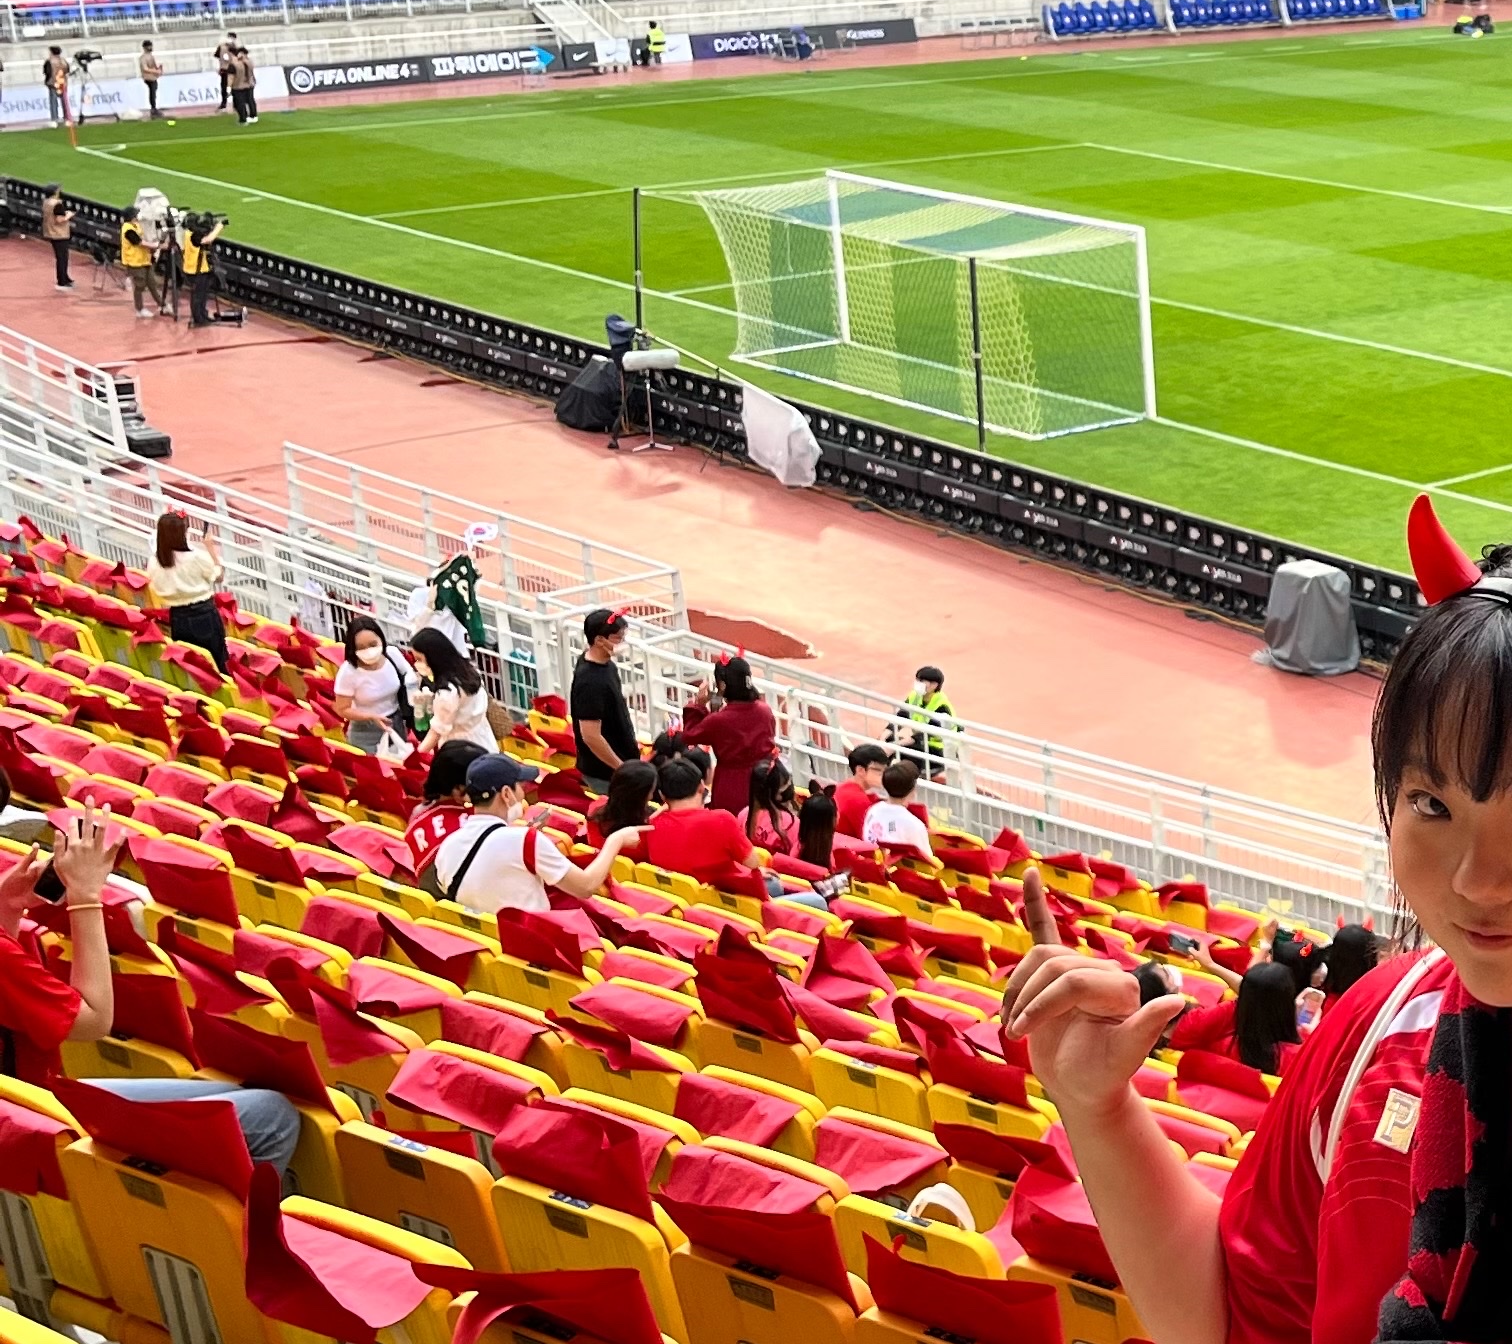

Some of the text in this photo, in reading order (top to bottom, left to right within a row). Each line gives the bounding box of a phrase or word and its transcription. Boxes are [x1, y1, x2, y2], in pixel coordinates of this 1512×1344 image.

[314, 69, 347, 86] FIFA
[350, 64, 400, 83] ONLINE
[400, 63, 410, 79] 4
